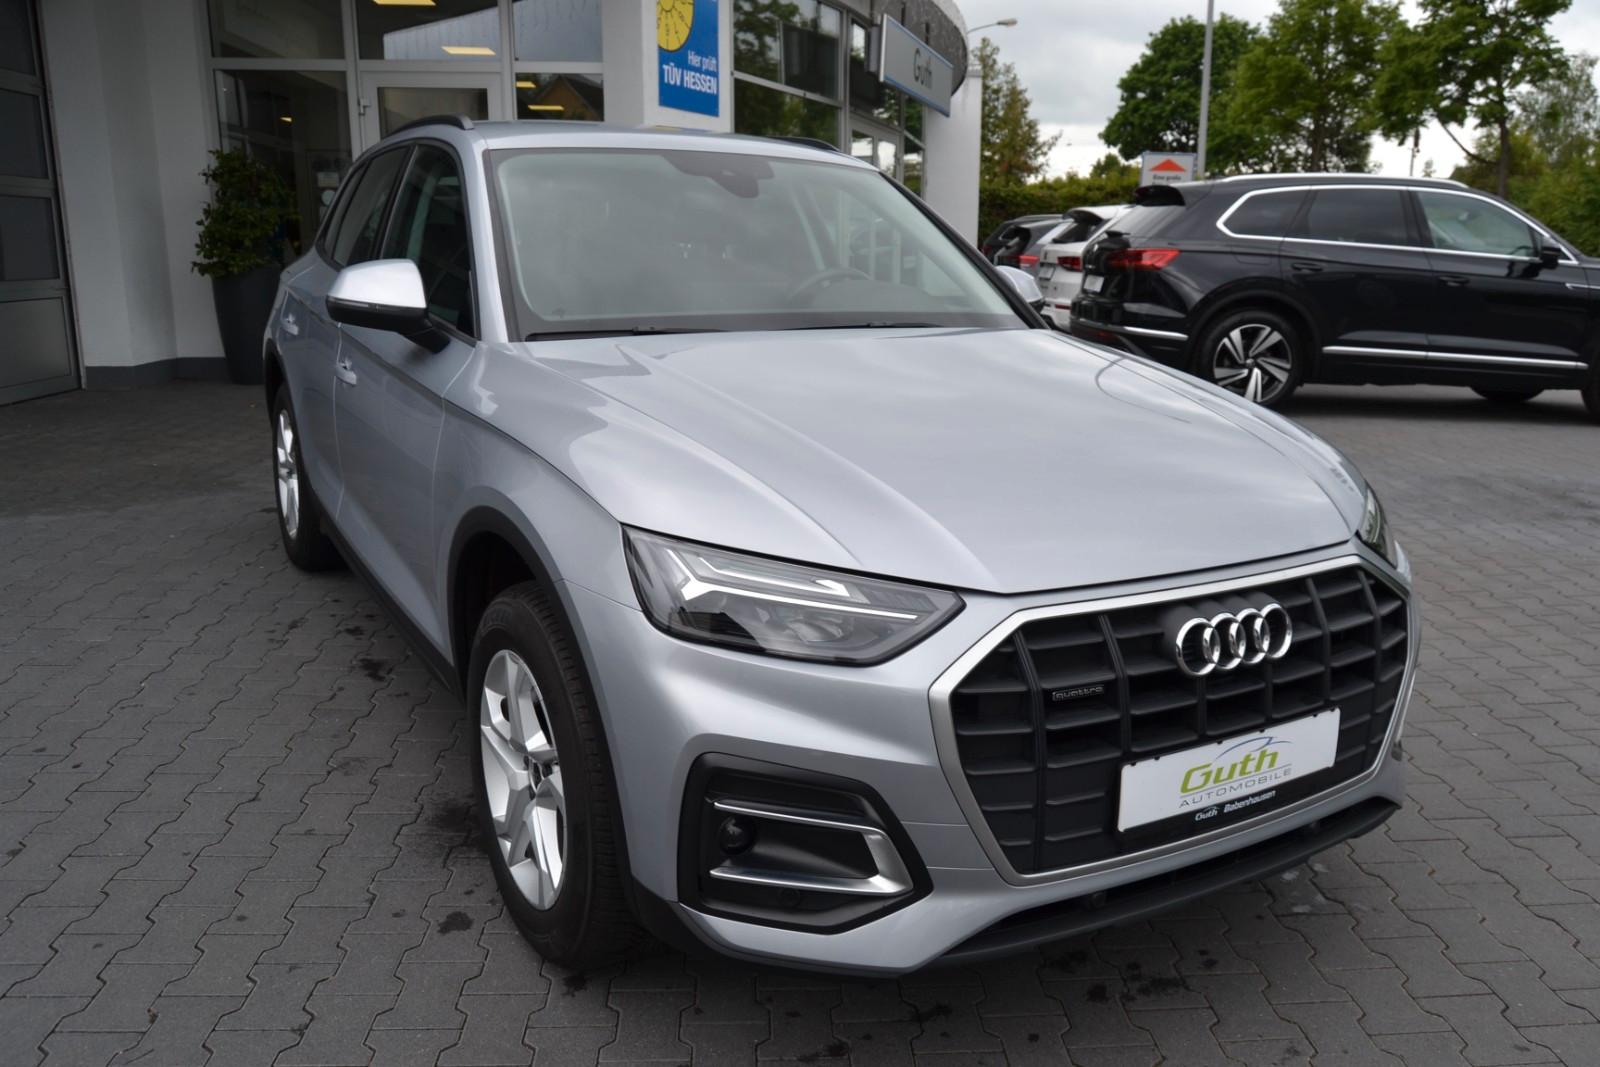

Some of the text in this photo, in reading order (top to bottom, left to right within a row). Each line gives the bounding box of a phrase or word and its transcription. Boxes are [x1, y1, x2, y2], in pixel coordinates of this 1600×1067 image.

[687, 50, 717, 72] Hier prüft
[662, 62, 718, 95] TÜV HESSEN
[1052, 686, 1104, 701] quattro
[1180, 749, 1279, 794] Guth
[1178, 768, 1293, 808] AUTOMOBILE
[1195, 807, 1218, 821] Guth
